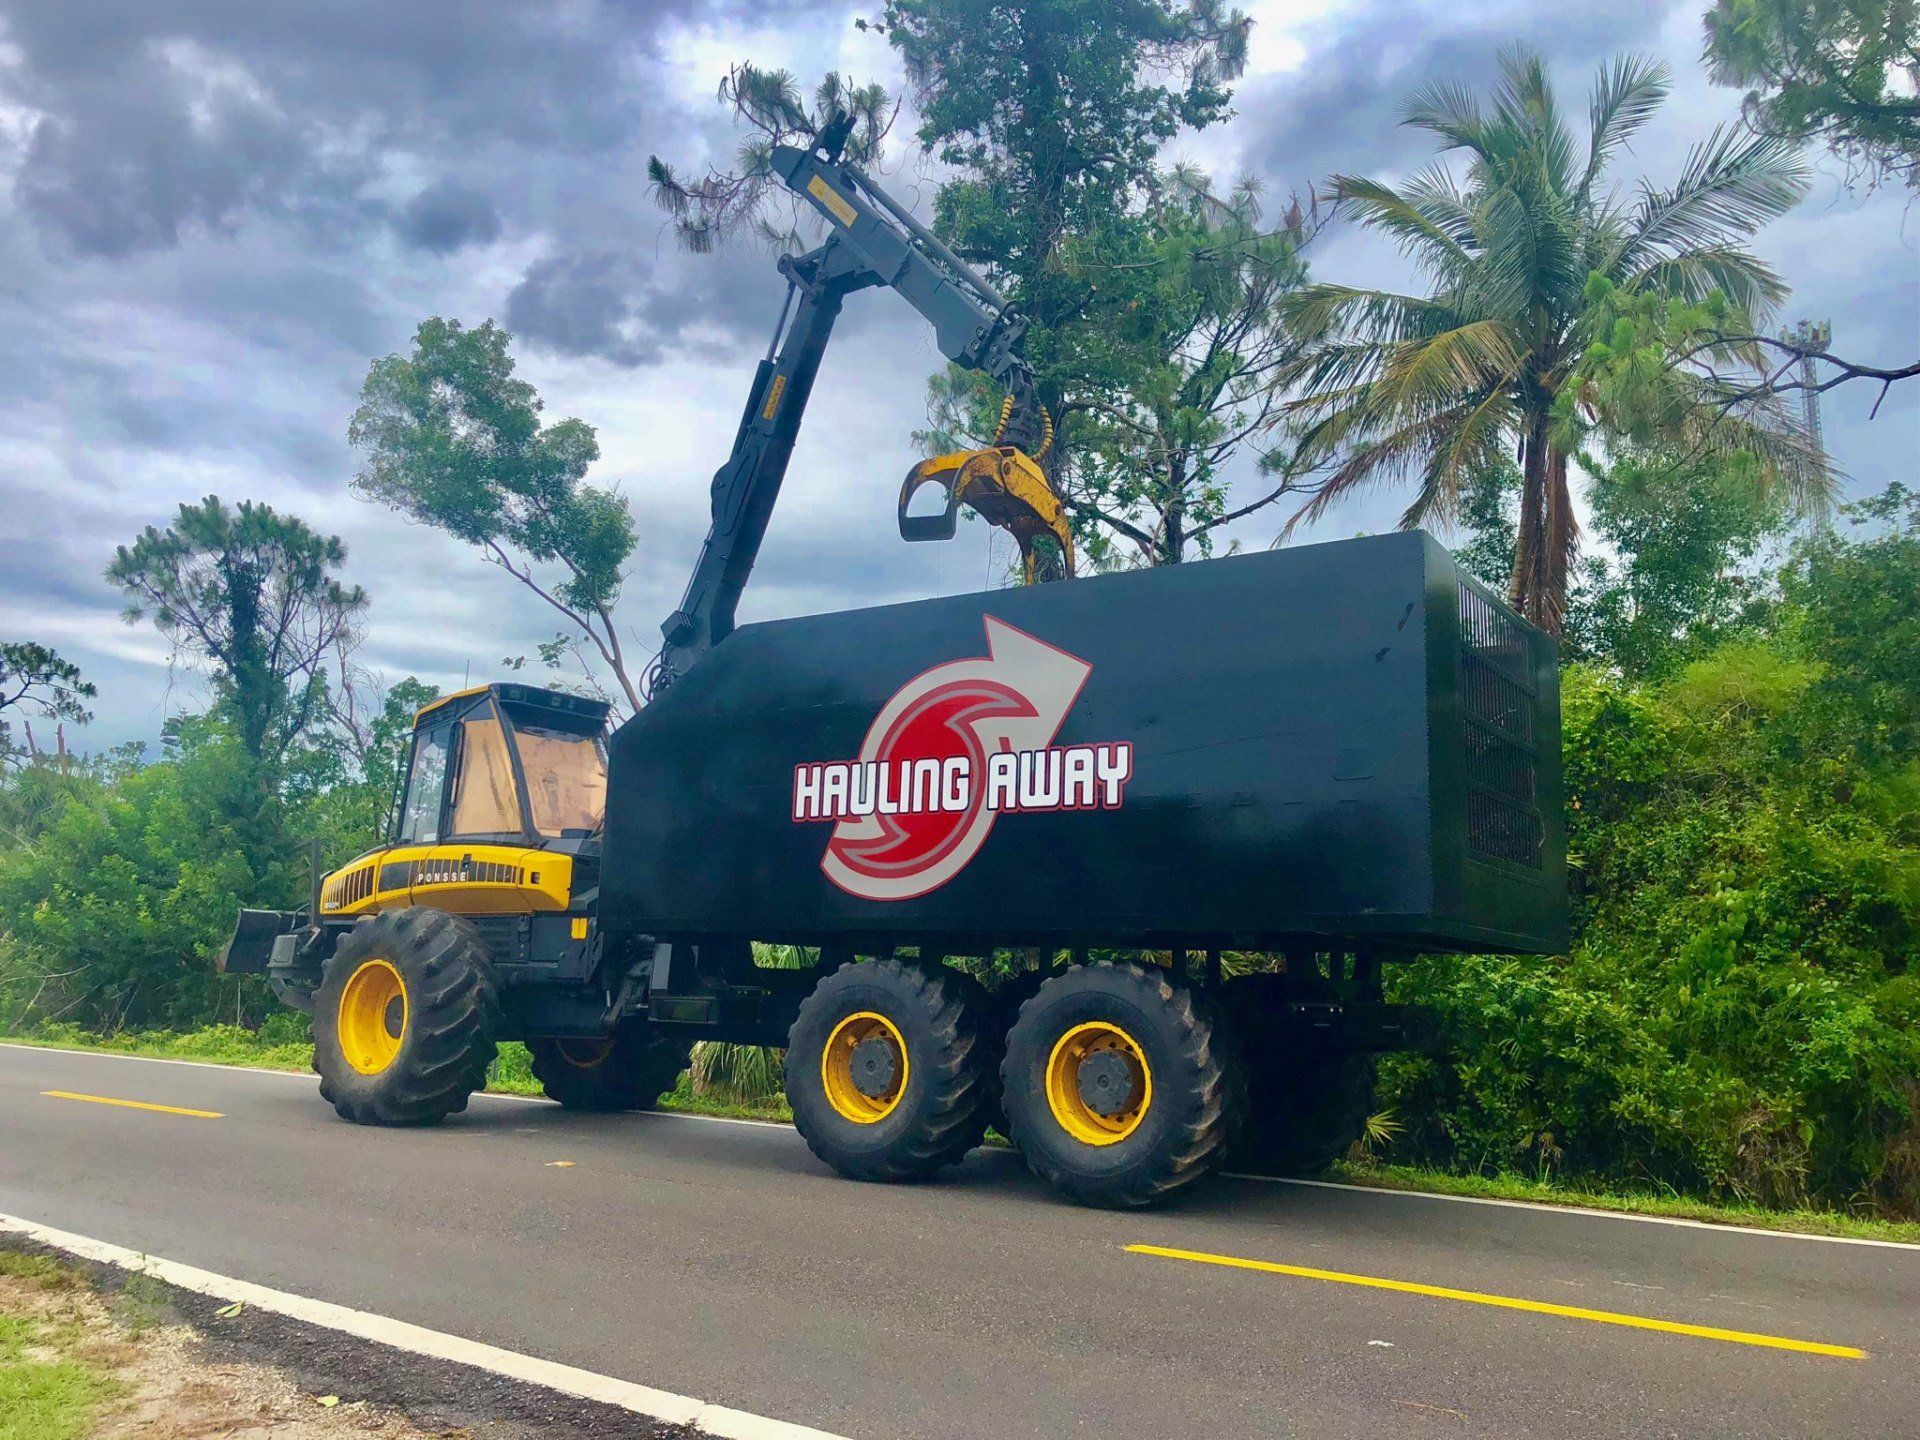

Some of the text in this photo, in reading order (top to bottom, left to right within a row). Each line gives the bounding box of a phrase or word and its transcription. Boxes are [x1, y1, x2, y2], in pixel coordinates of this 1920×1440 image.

[795, 745, 1129, 818] HAULING AWAY
[418, 872, 466, 883] PONSSE
